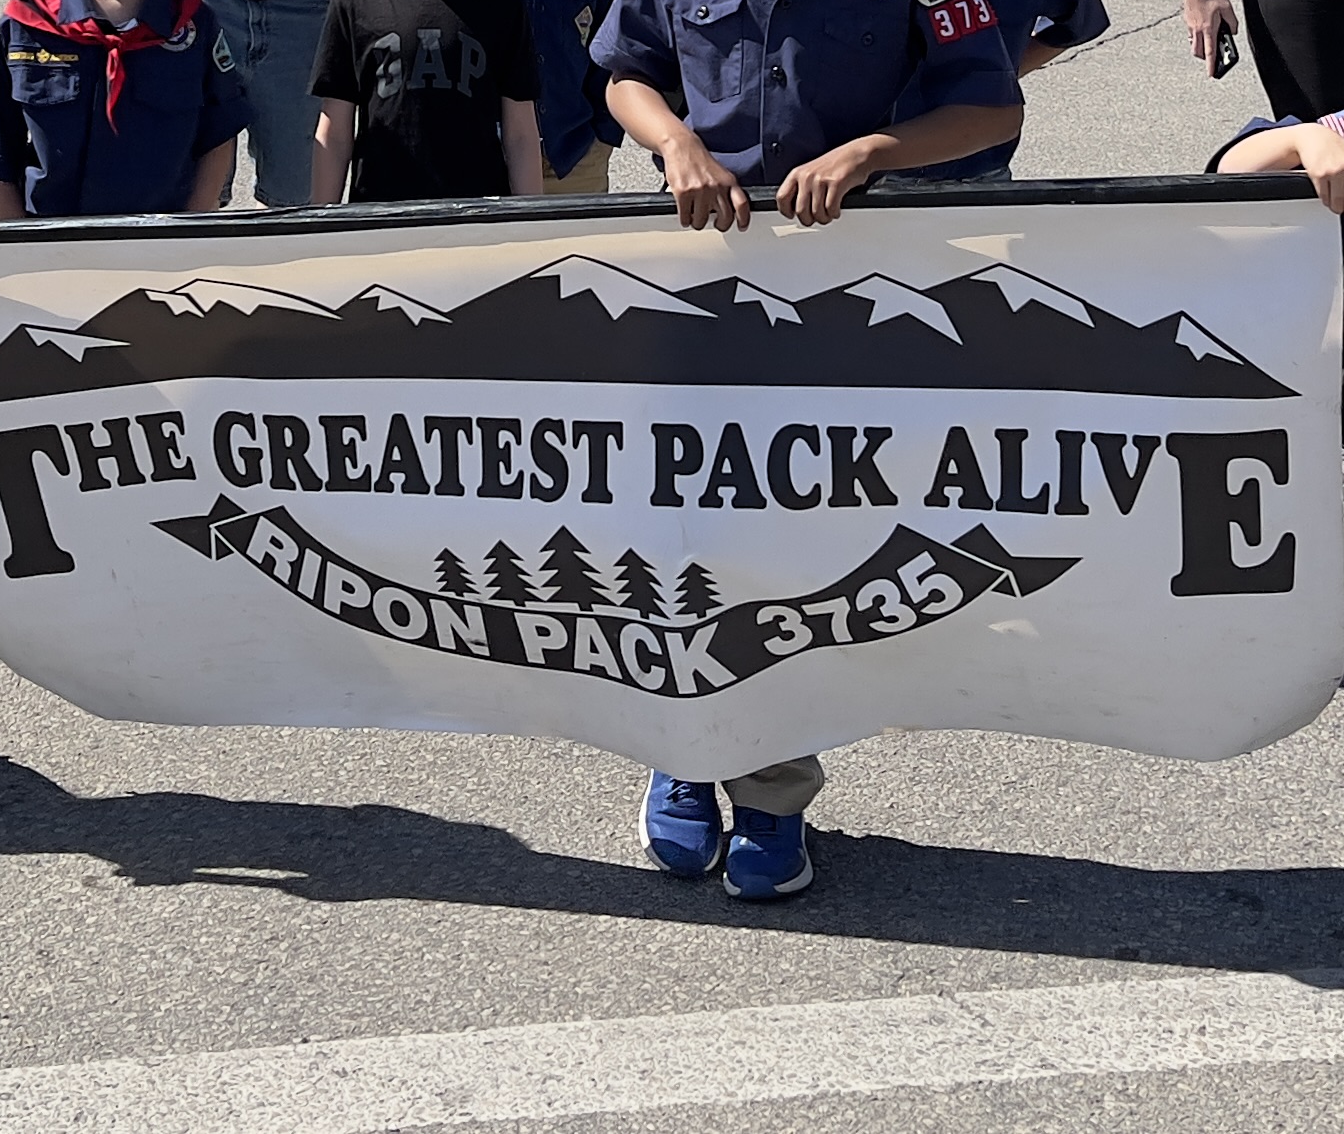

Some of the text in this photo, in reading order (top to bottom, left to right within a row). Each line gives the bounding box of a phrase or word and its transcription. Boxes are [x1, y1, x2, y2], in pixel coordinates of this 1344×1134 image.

[359, 28, 487, 99] GAP
[212, 411, 624, 504] GREATEST
[650, 422, 898, 510] PACK
[924, 425, 1297, 597] ALIVE
[244, 515, 965, 695] RIPON PACK 3735
